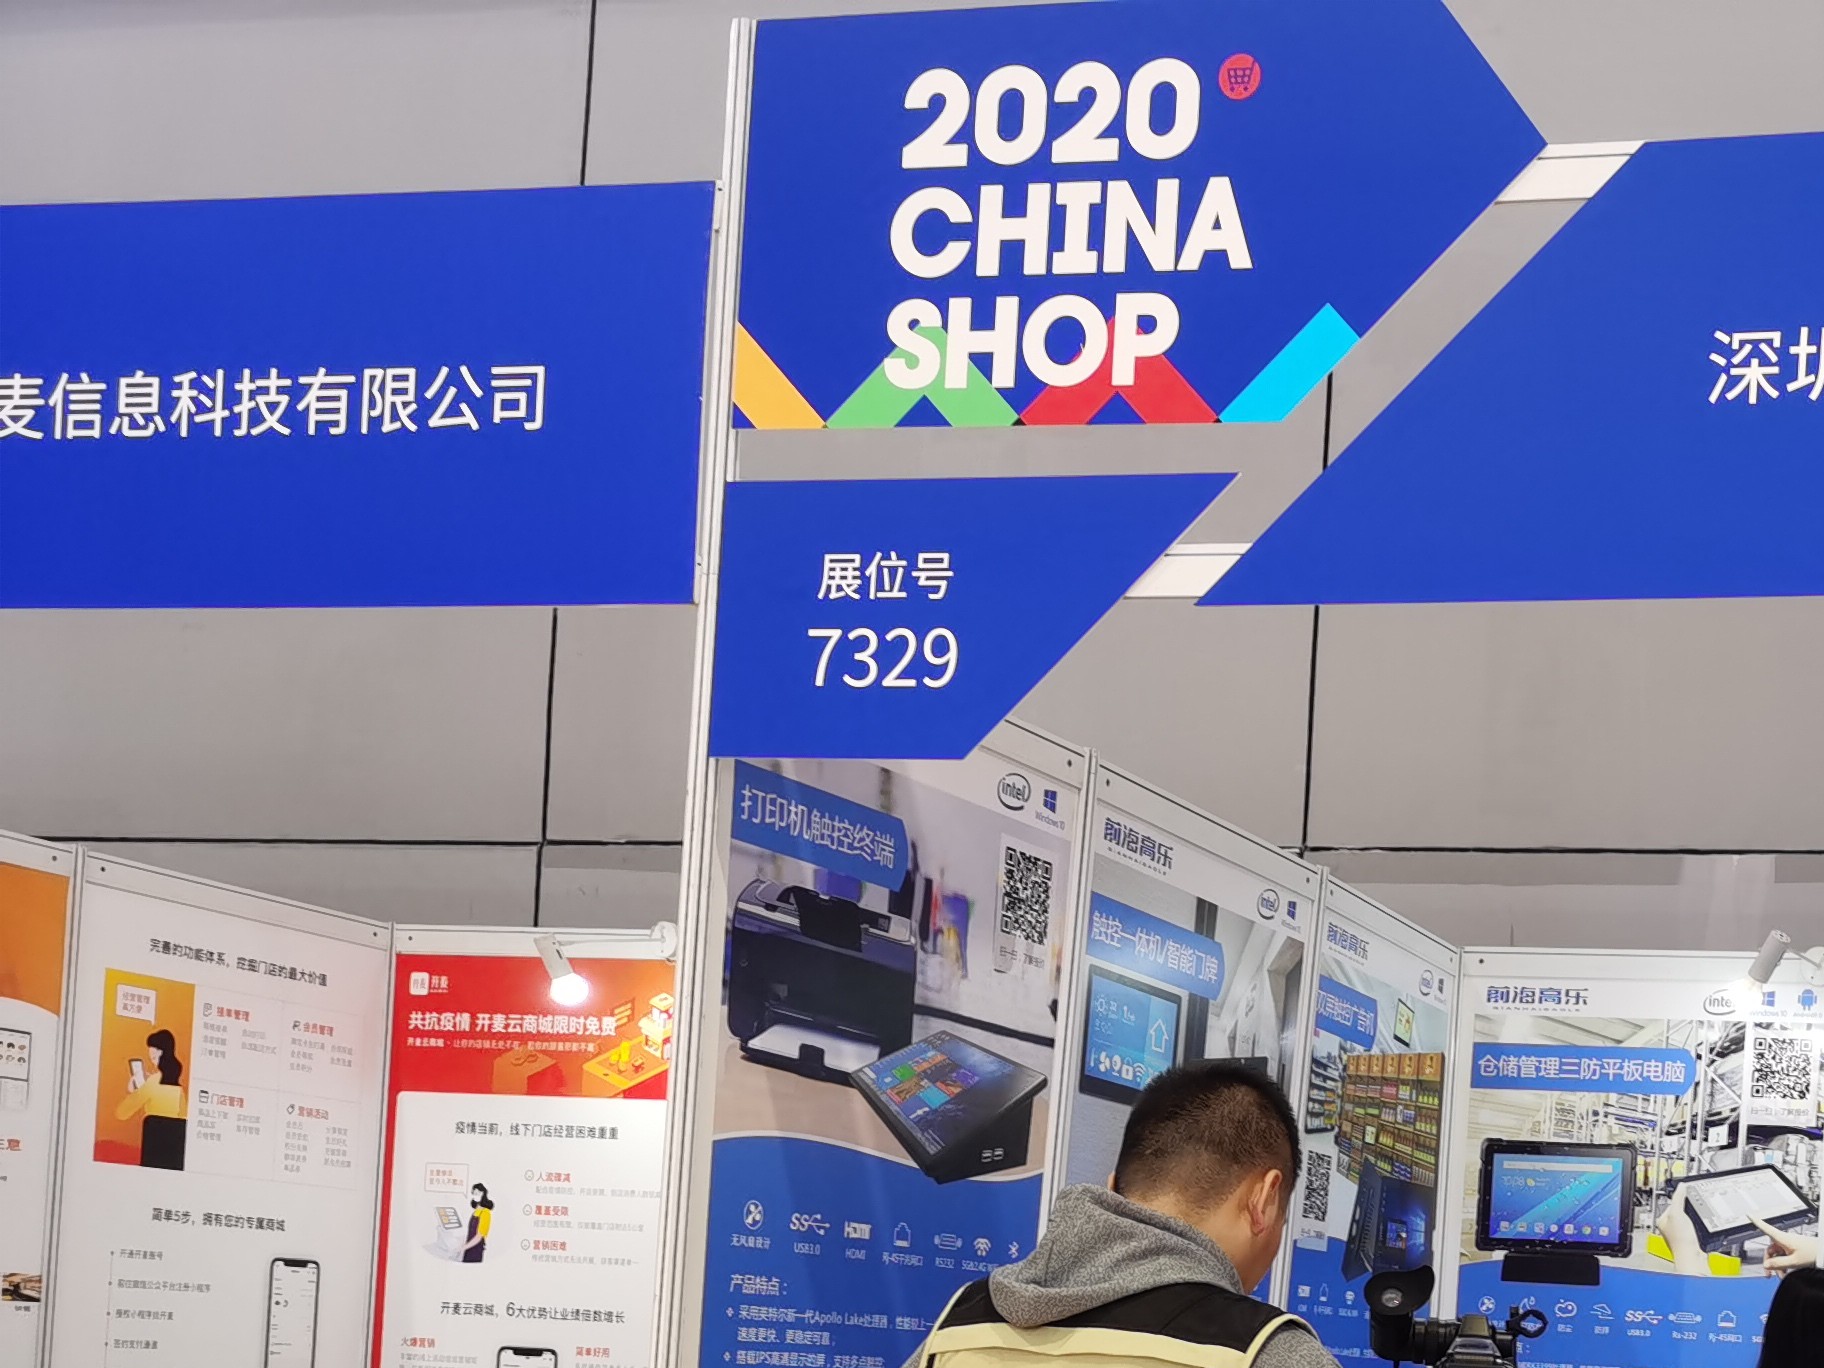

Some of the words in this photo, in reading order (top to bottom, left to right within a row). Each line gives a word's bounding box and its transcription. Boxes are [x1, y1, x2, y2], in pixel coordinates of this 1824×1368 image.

[901, 57, 1201, 168] 2020
[889, 176, 1253, 279] CHINA
[882, 293, 1181, 390] SHOP
[0, 364, 547, 440] 麦信息科技有限公司
[817, 551, 955, 601] 展位号
[807, 627, 960, 689] 7329
[1000, 775, 1029, 806] intel
[741, 784, 895, 869] 打印机触控终端
[1104, 817, 1173, 870] 前海高乐
[1486, 985, 1590, 1006] 前海高乐
[408, 1012, 471, 1031] 共抗疫情
[476, 1013, 617, 1036] 开麦云商城限时免费
[1478, 1054, 1687, 1084] 仓储管理三防平板电脑
[793, 1241, 821, 1255] USB3.0
